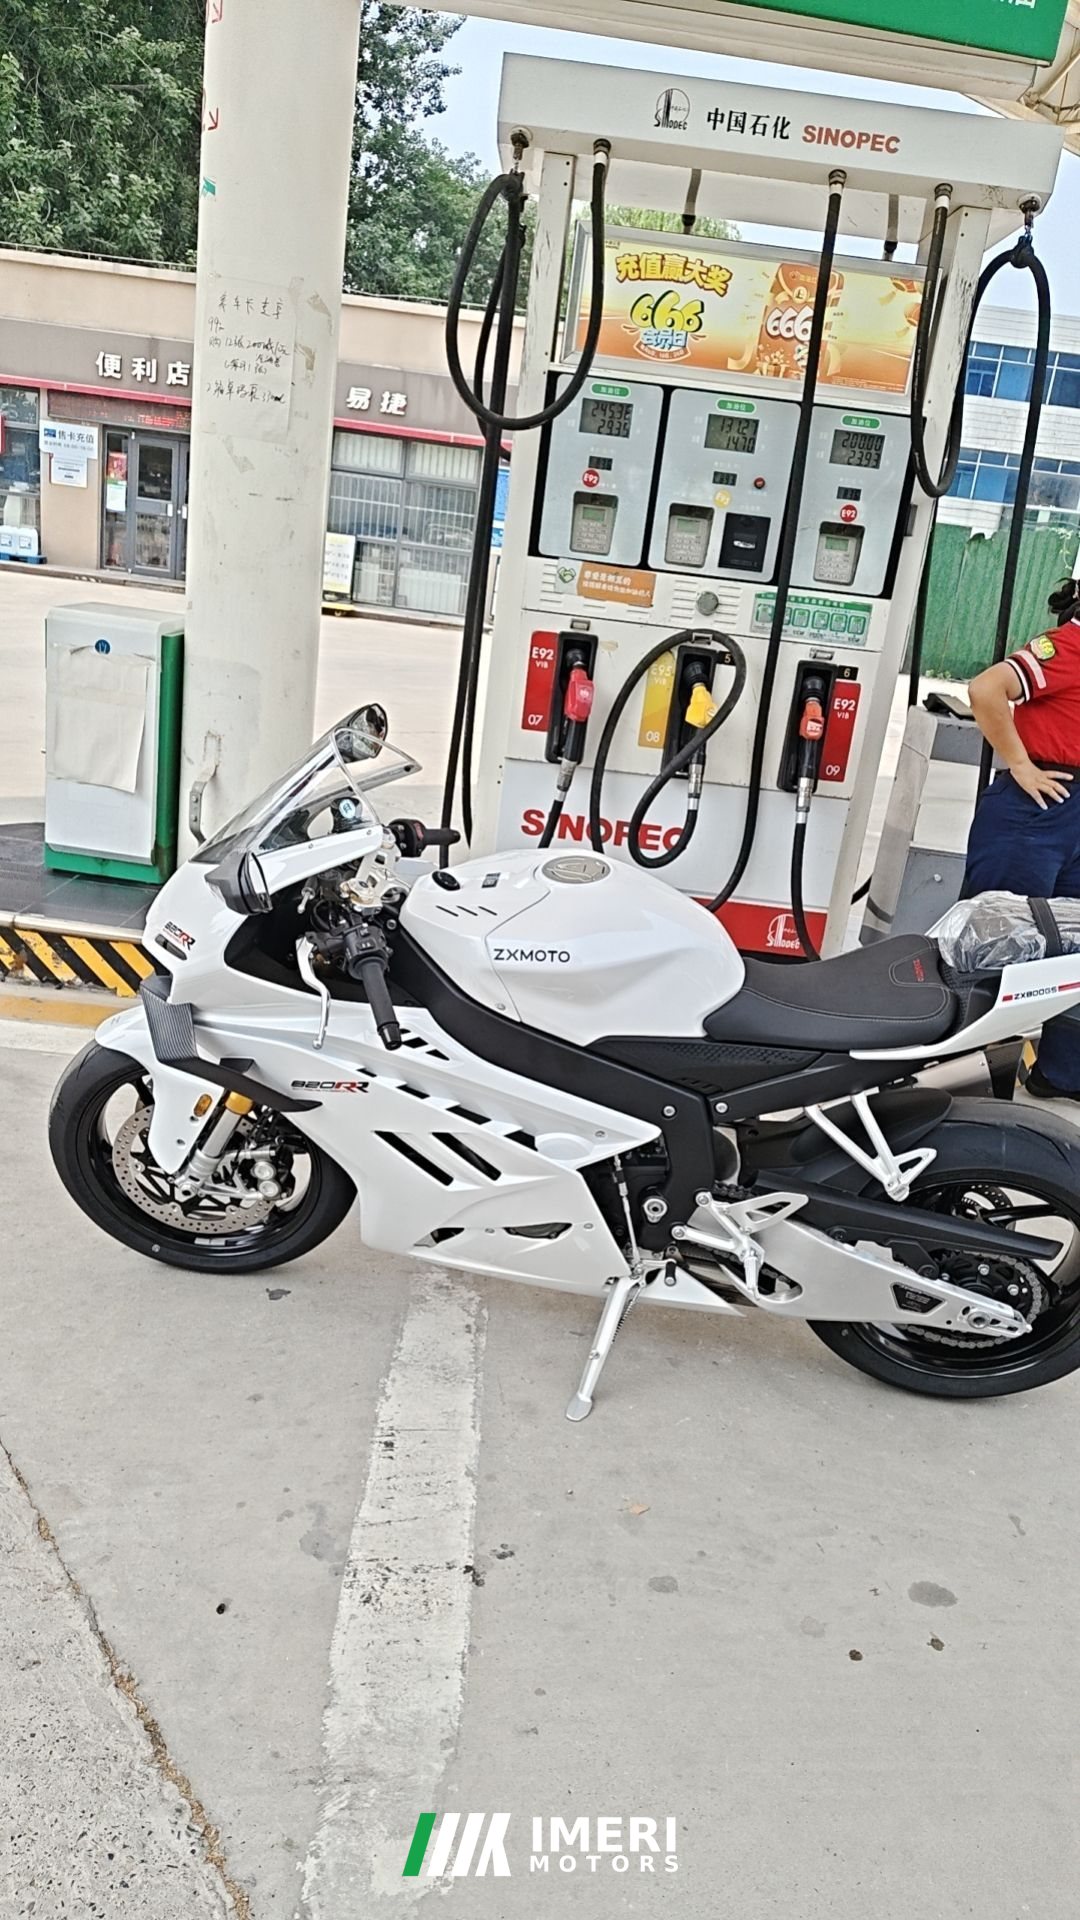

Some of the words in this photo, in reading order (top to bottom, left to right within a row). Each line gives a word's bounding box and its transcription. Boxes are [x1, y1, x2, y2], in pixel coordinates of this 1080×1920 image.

[706, 107, 791, 140] 中国石化
[802, 125, 900, 154] SINOPEC
[615, 252, 732, 297] 充值赢大奖
[630, 290, 704, 332] 666
[95, 351, 190, 386] 便利店
[346, 387, 407, 416] 易捷
[583, 473, 598, 485] E92
[841, 509, 856, 518] E92
[531, 646, 554, 660] E92
[724, 653, 731, 663] 5
[650, 663, 673, 677] E95
[844, 668, 851, 678] 6
[833, 698, 856, 711] E92
[527, 714, 543, 726] 07
[645, 730, 661, 743] 08
[825, 765, 840, 776] 09
[493, 949, 571, 963] ZXMOTO
[291, 1080, 369, 1093] 820RR
